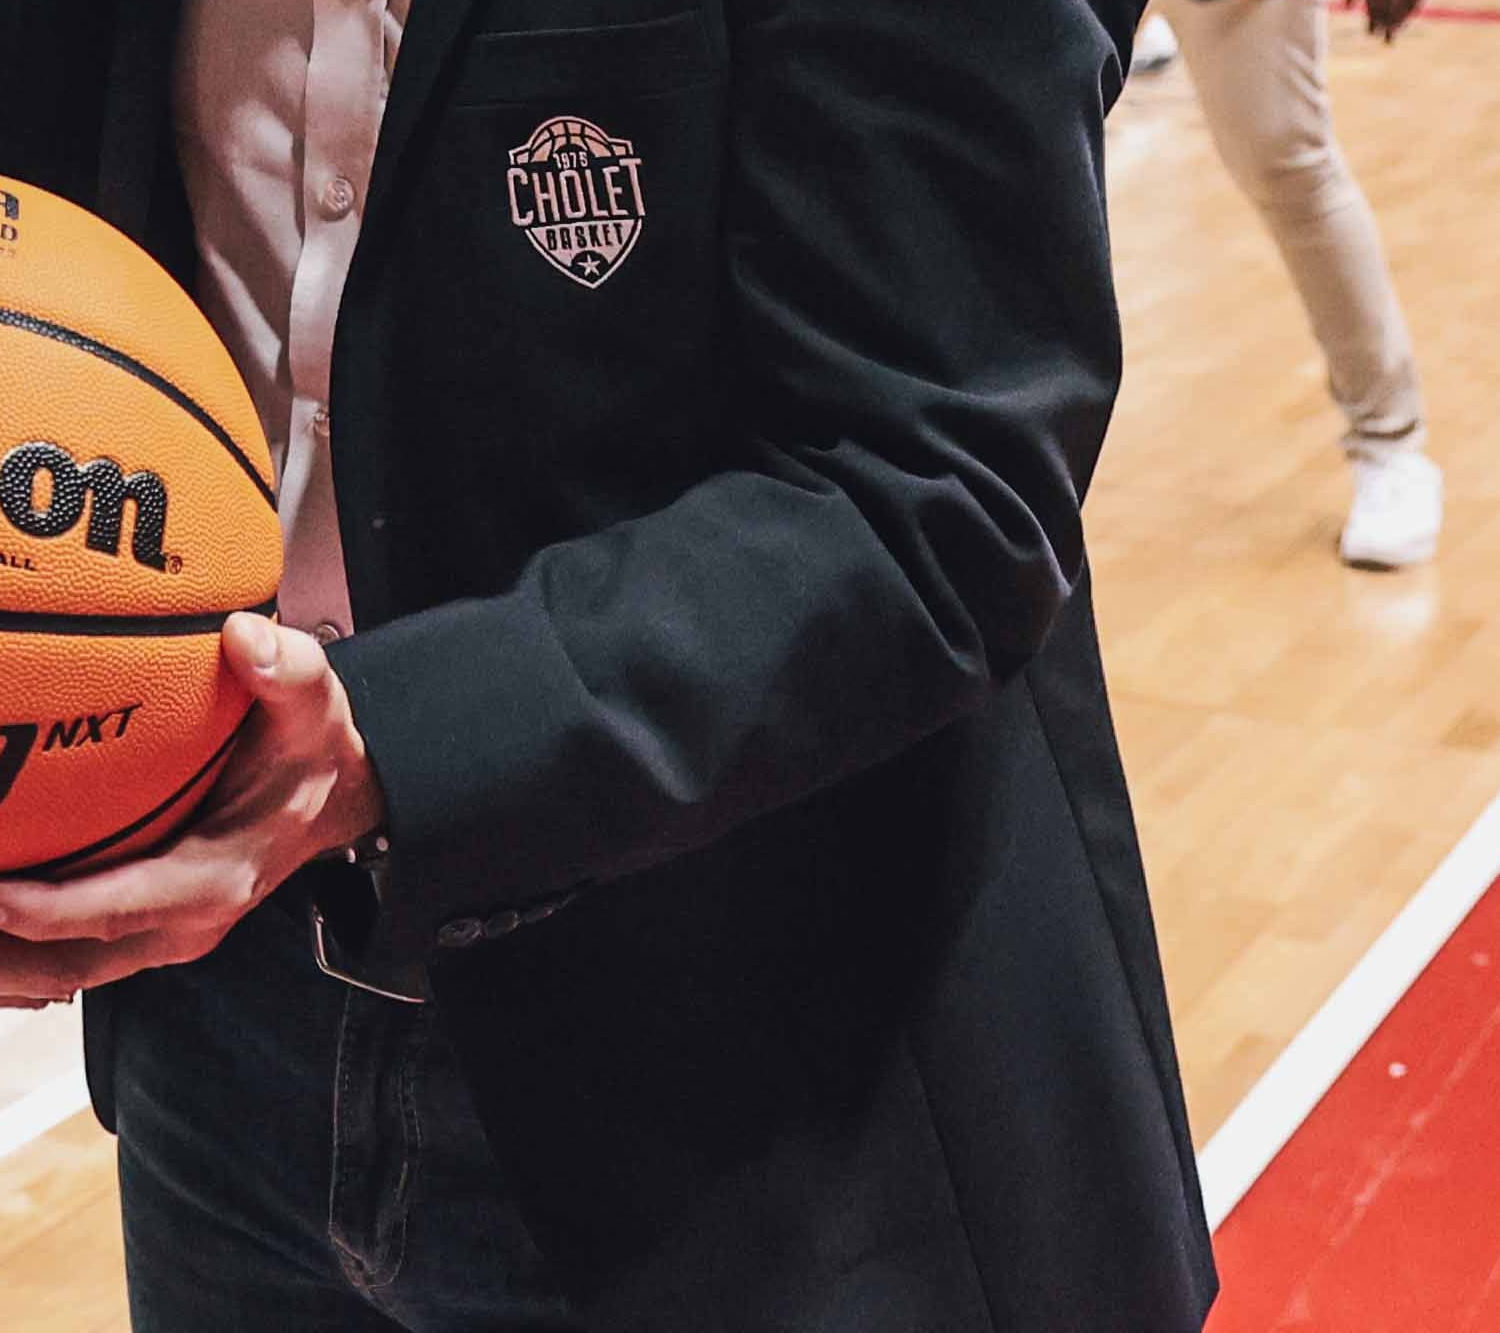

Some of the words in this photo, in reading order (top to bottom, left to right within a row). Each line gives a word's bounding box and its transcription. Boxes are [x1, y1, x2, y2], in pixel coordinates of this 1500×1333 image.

[552, 150, 589, 171] 1975
[506, 157, 646, 227] CHOLET
[545, 222, 625, 252] BASKET
[42, 702, 144, 751] NXT
